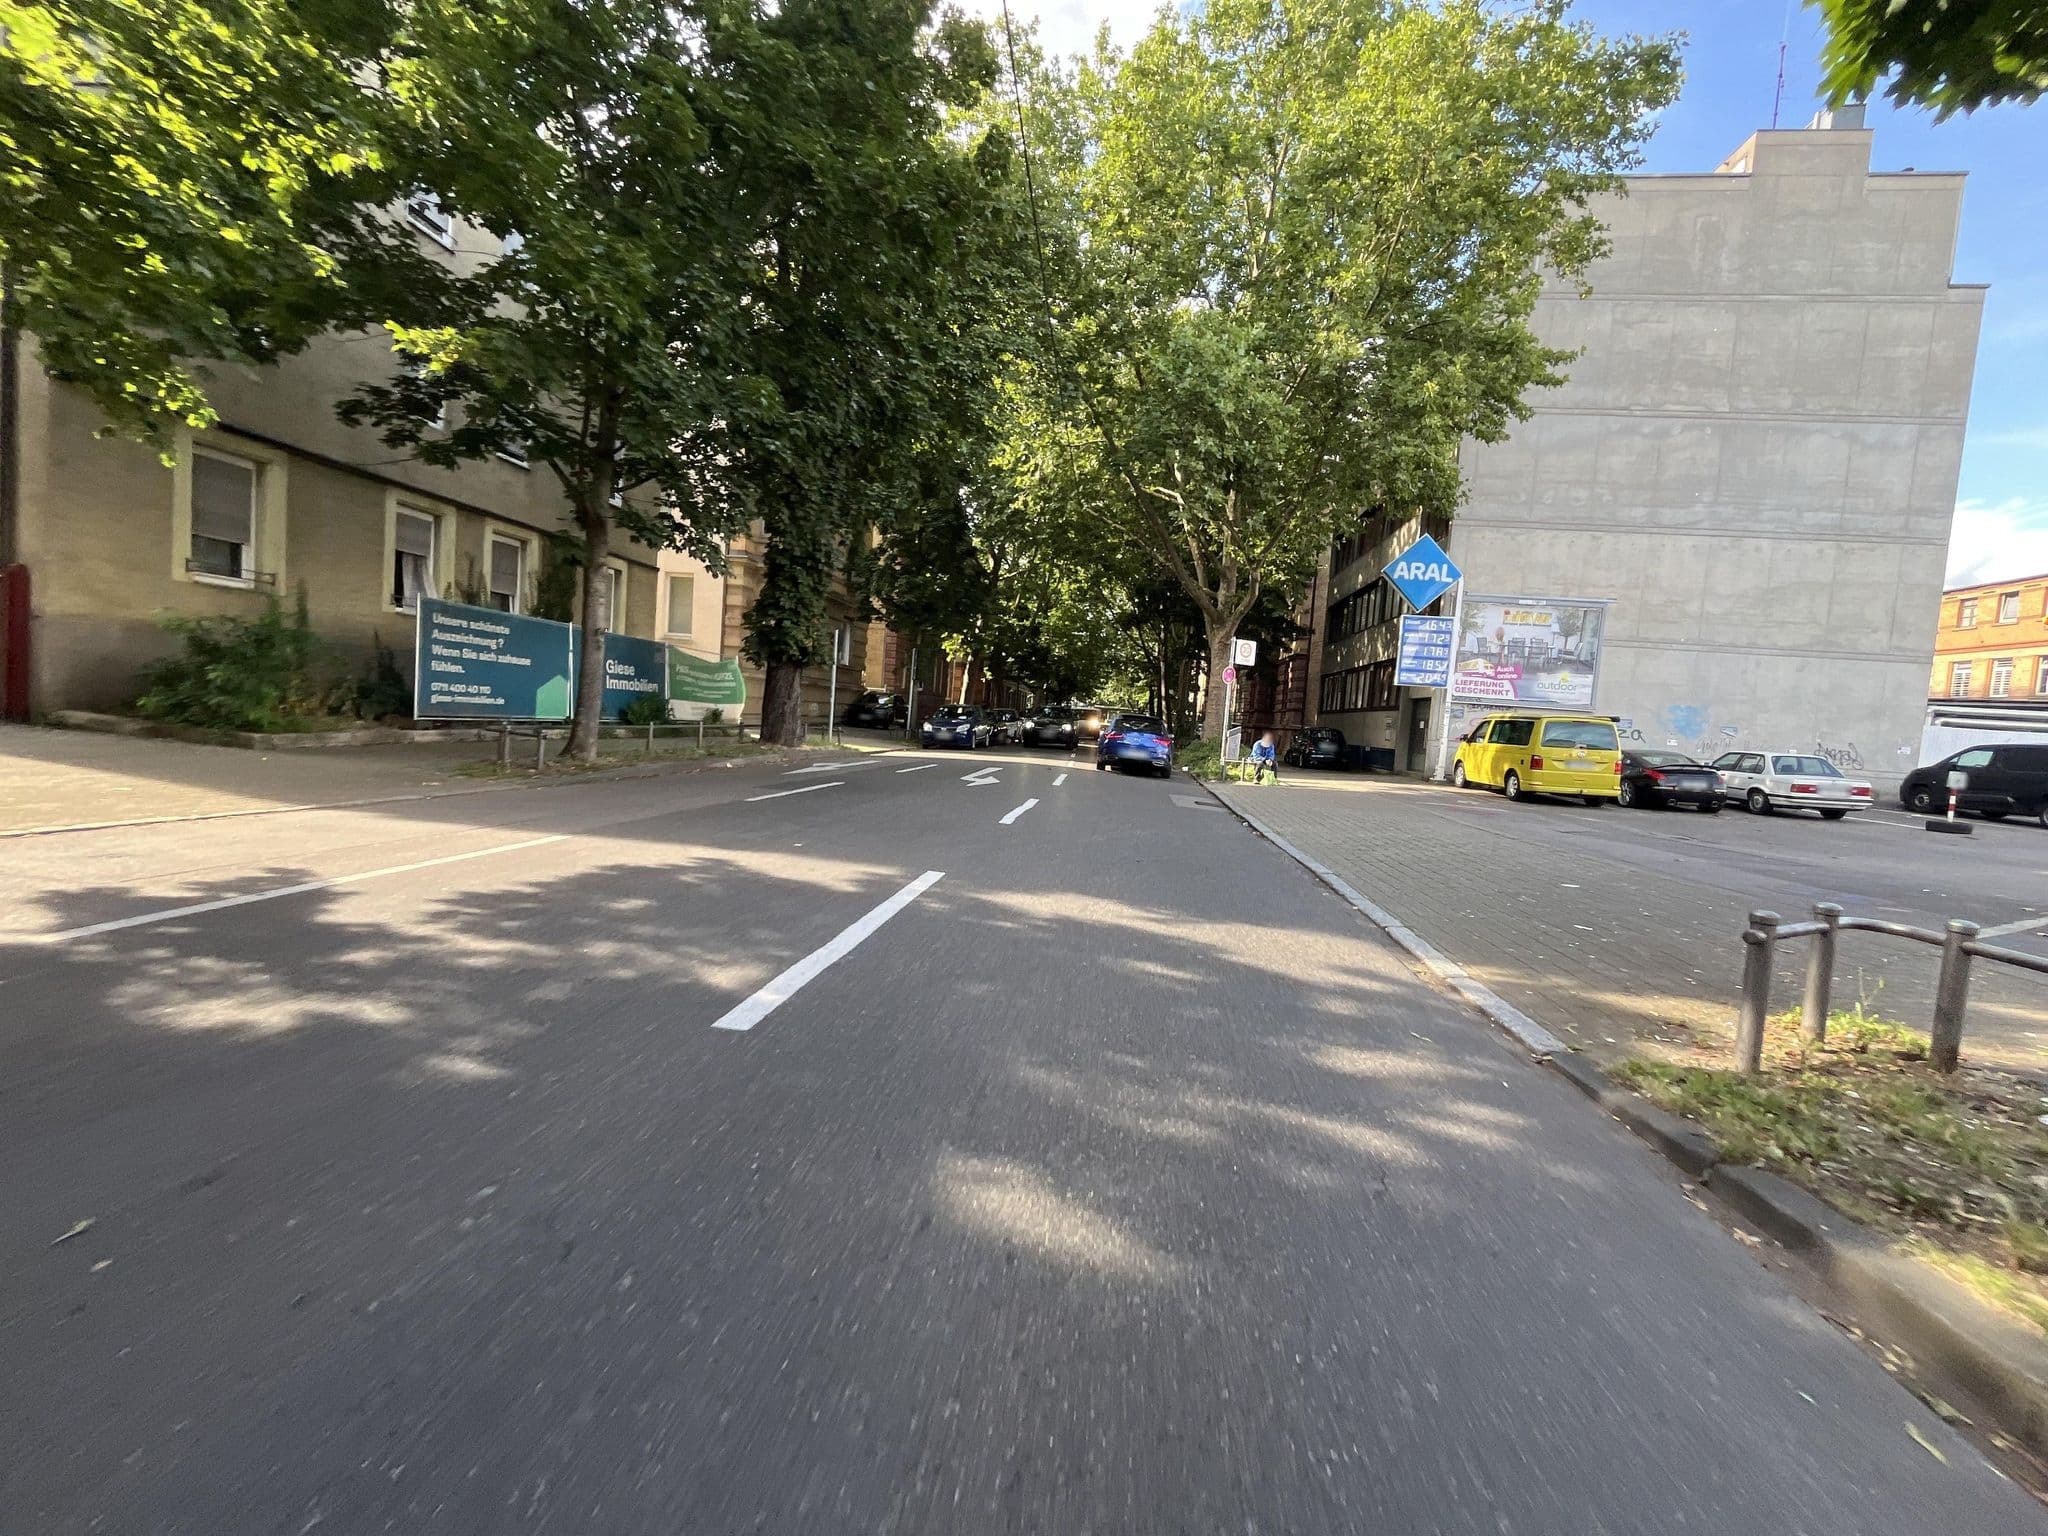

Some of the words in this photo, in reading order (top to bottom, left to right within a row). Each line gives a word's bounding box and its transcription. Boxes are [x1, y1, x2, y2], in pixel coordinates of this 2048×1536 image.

[1393, 561, 1453, 582] ARAL
[432, 612, 468, 628] Unsere
[431, 644, 460, 657] Wenn
[462, 648, 478, 659] Sie
[479, 651, 497, 661] sich
[605, 659, 635, 675] Giese
[1496, 665, 1515, 673] Auch
[1497, 672, 1518, 680] online
[450, 683, 467, 693] 400
[606, 675, 659, 693] Immobilien
[1455, 679, 1505, 689] LIEFERUNG
[1537, 680, 1577, 692] outdoor
[1454, 686, 1511, 697] GESCHENKT
